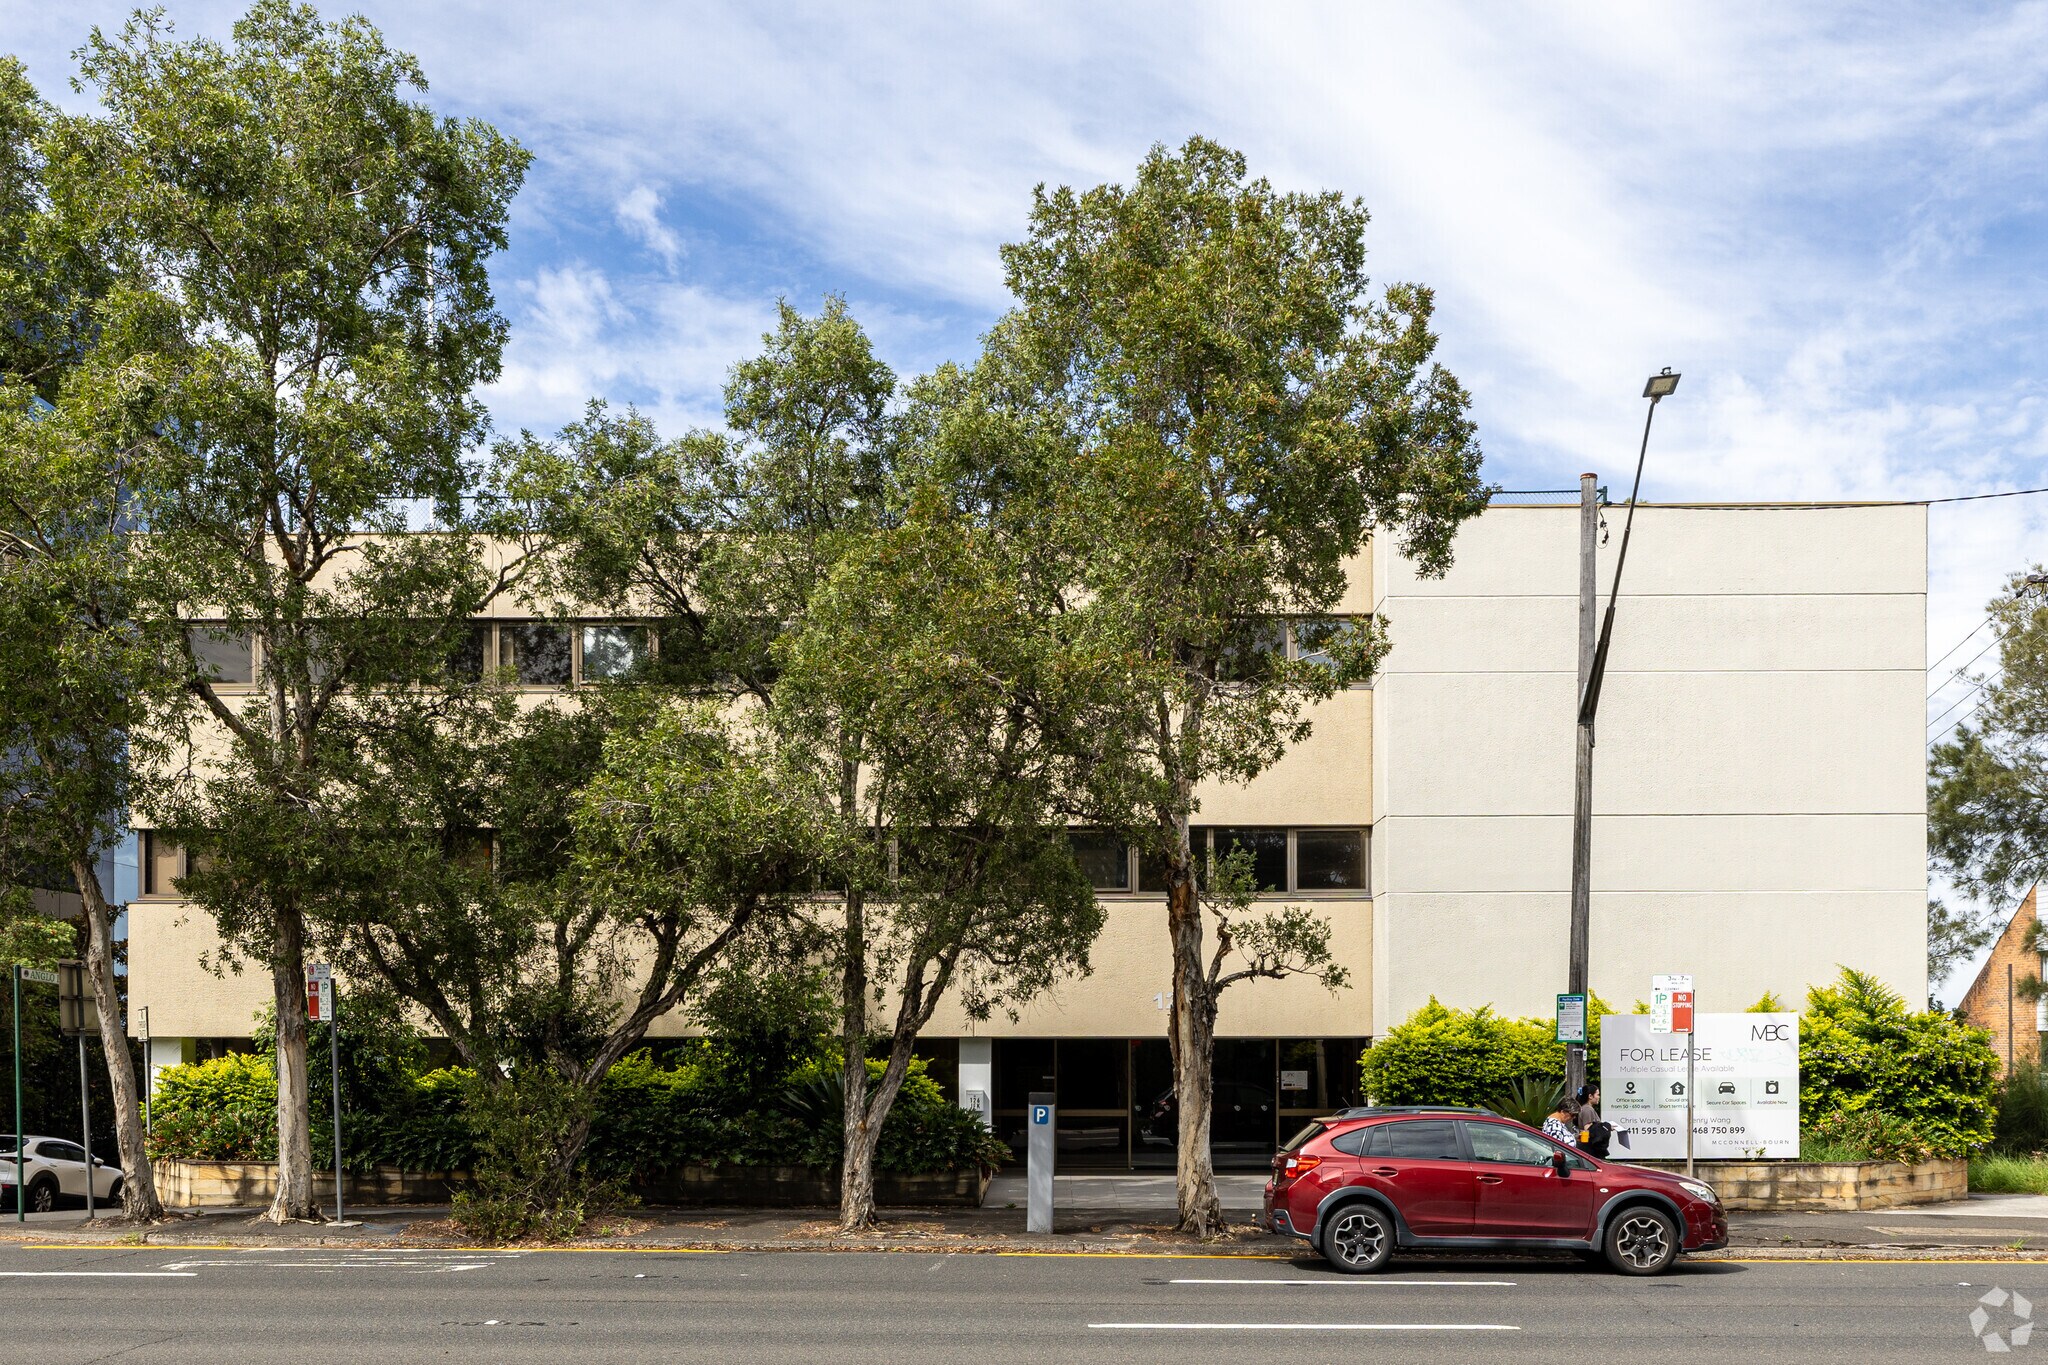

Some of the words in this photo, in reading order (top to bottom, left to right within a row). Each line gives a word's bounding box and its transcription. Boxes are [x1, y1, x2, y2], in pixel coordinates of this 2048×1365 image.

[30, 971, 55, 982] ANGLO
[1655, 993, 1667, 1004] 1P
[1751, 1024, 1789, 1041] MBC
[1620, 1048, 1655, 1061] FOR
[1660, 1048, 1712, 1061] LEASE
[1620, 1065, 1648, 1073] Multiple
[1037, 1109, 1046, 1122] P
[1640, 1117, 1661, 1125] Wang
[1710, 1117, 1731, 1125] Wang
[1627, 1127, 1639, 1135] 411
[1641, 1127, 1657, 1135] 595
[1660, 1127, 1676, 1135] 870
